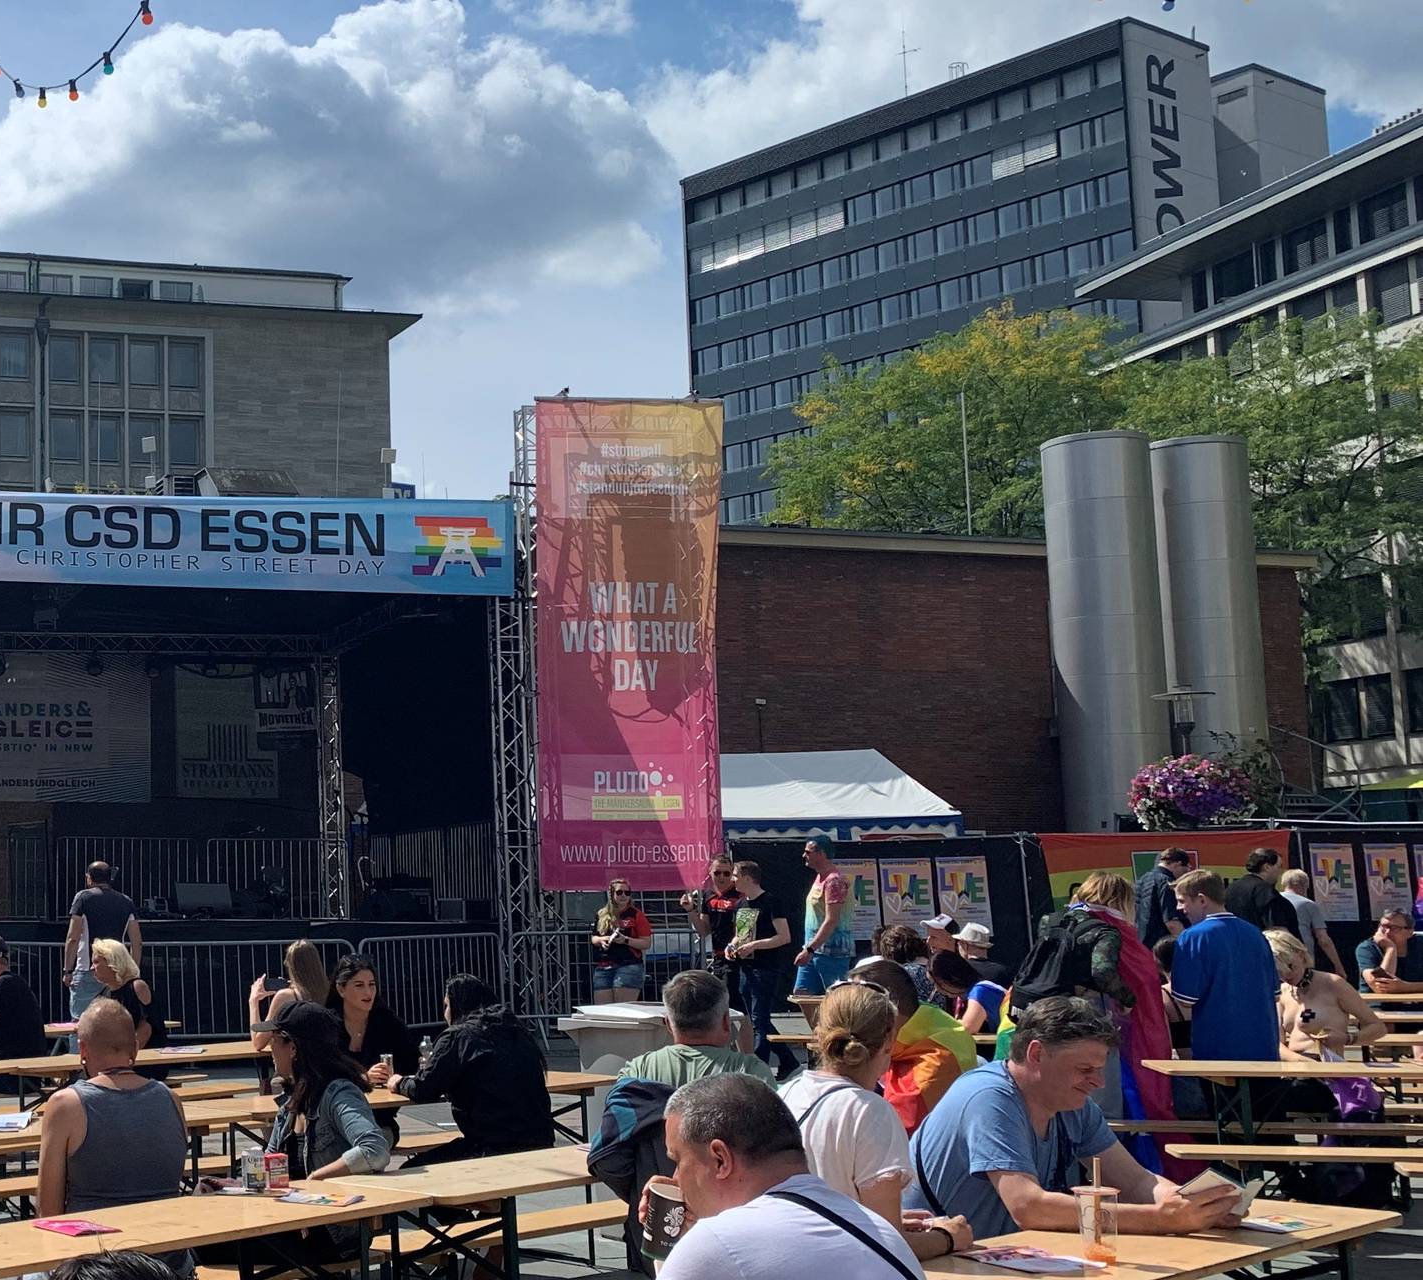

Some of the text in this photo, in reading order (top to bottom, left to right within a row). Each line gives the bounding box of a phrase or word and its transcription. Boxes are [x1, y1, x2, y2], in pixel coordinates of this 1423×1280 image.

[601, 443, 661, 457] #stonewall
[65, 504, 181, 549] CSD
[201, 508, 385, 556] ESSEN
[16, 549, 200, 570] CHRISTOPHER
[221, 556, 317, 574] STREET
[338, 560, 385, 575] DAY
[588, 582, 677, 614] WHAT A
[560, 620, 698, 653] WONDERFUL
[613, 659, 659, 691] DAY
[45, 743, 58, 752] IN
[64, 743, 94, 752] NRW
[593, 770, 649, 793] PLUTO
[560, 840, 710, 866] www.pluto-essen.tv
